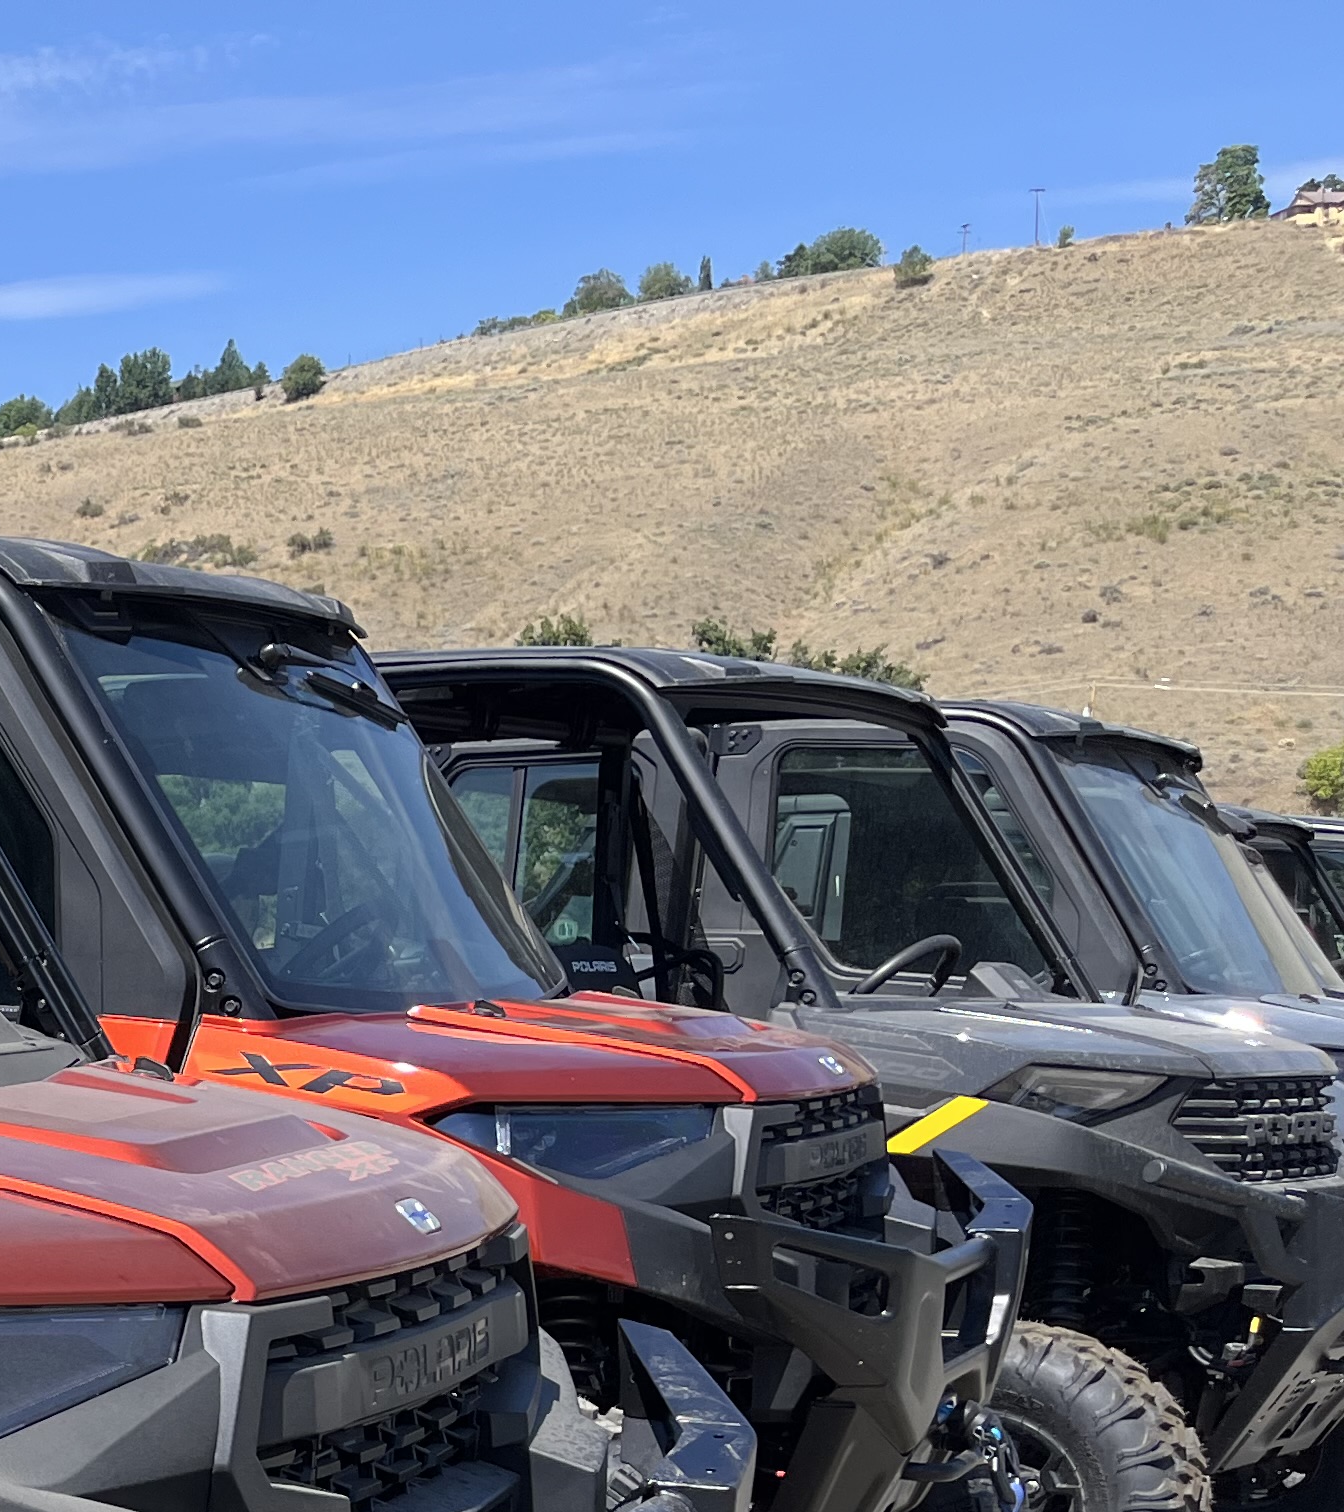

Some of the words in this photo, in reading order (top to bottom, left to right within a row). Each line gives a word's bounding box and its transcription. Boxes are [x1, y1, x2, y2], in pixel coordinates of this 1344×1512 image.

[571, 960, 618, 973] POLARIS
[205, 1051, 406, 1096] XP
[229, 1141, 392, 1191] RANGER
[336, 1155, 399, 1181] XP
[369, 1316, 490, 1405] POLARIS
